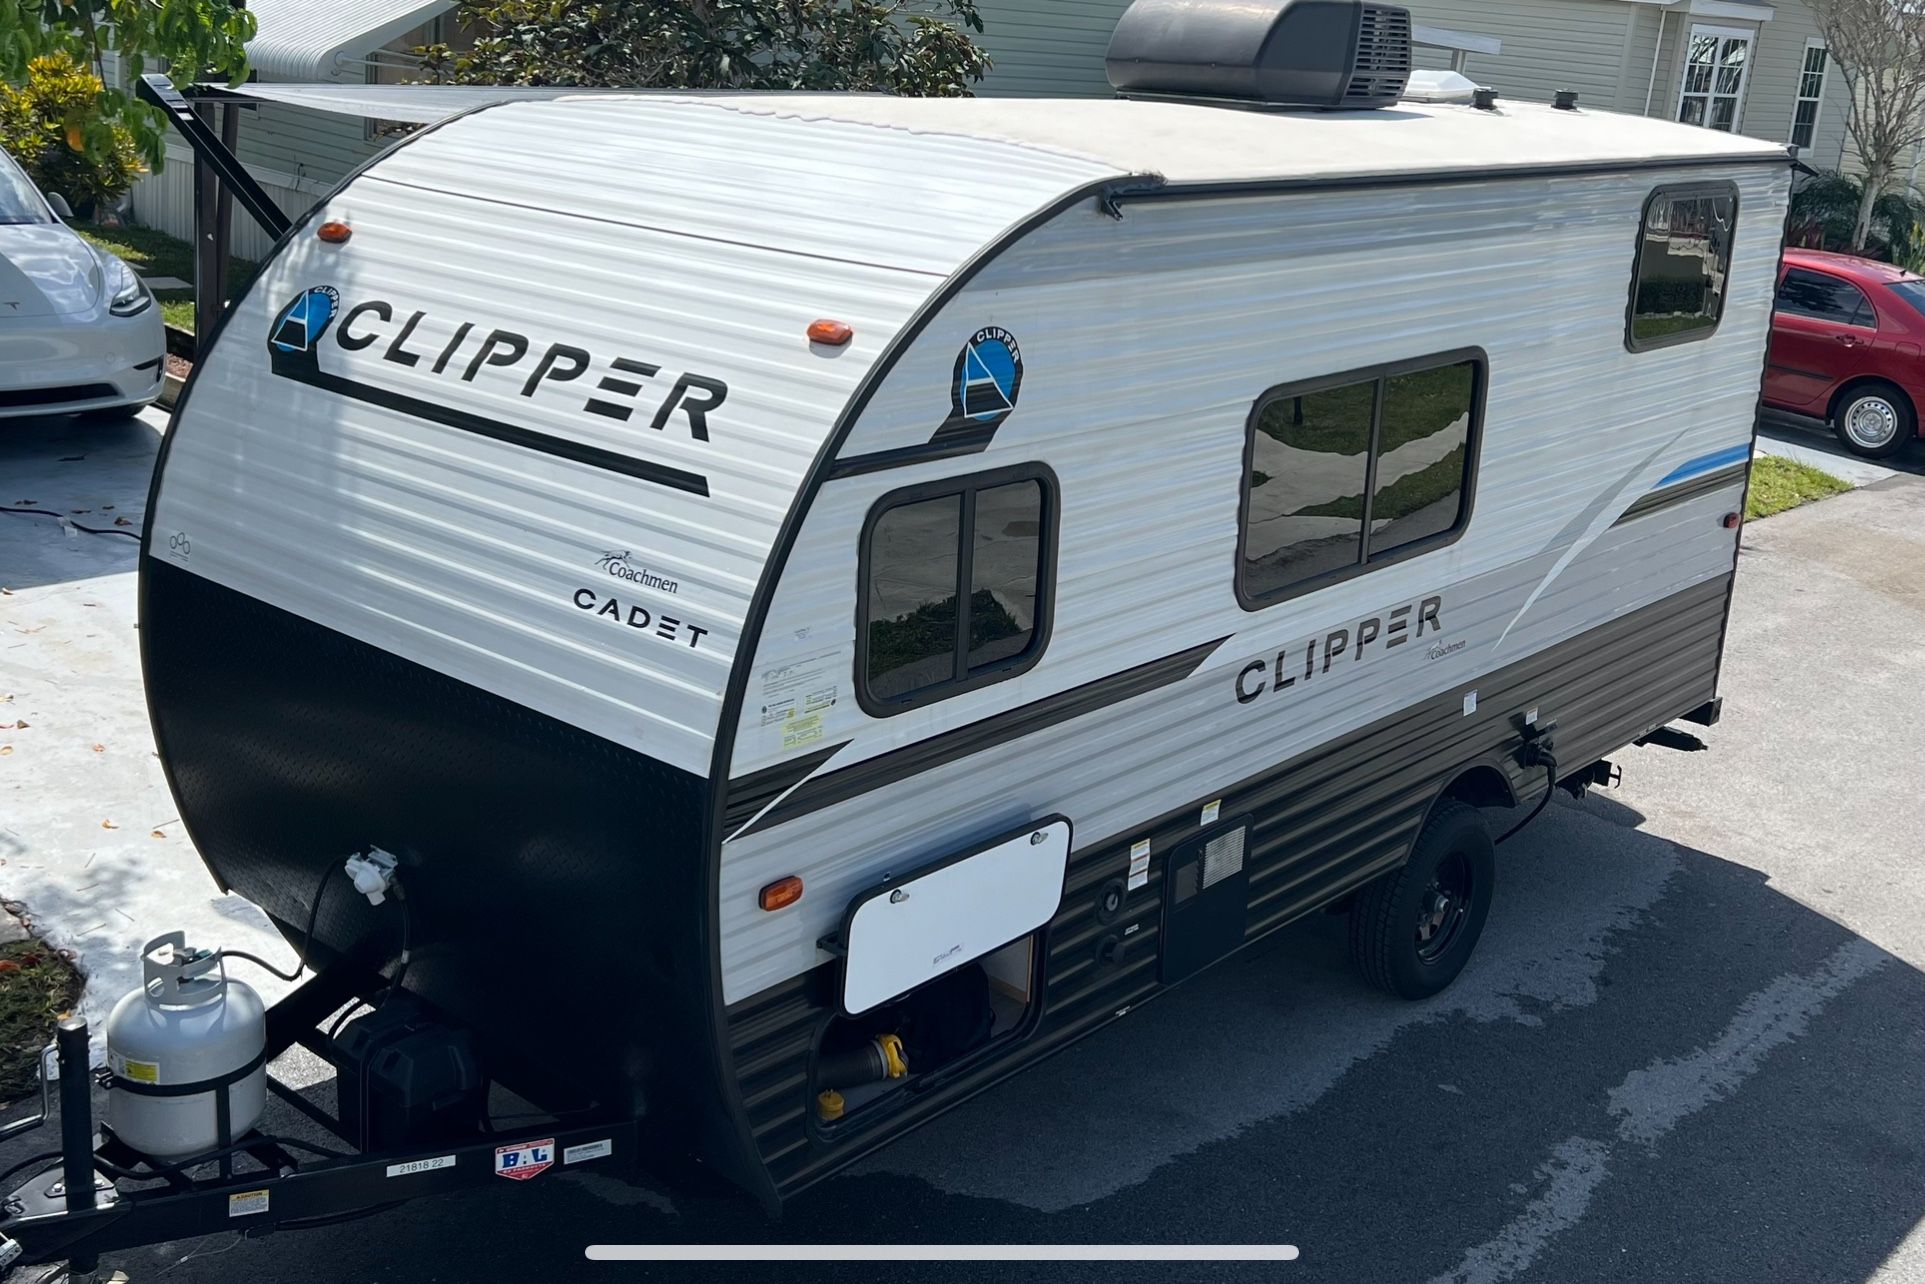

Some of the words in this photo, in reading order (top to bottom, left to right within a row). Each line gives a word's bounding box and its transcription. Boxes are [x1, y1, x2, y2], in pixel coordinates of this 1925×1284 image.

[313, 285, 339, 319] CLIPPER
[976, 328, 1020, 363] CLIPPER
[336, 300, 729, 442] CLIPPER
[608, 561, 678, 593] Coachmen
[573, 588, 709, 648] CADET
[1235, 595, 1442, 704] CLIPPER
[1430, 640, 1466, 660] Coachmen
[399, 1161, 429, 1173] 21818
[432, 1159, 444, 1168] 22
